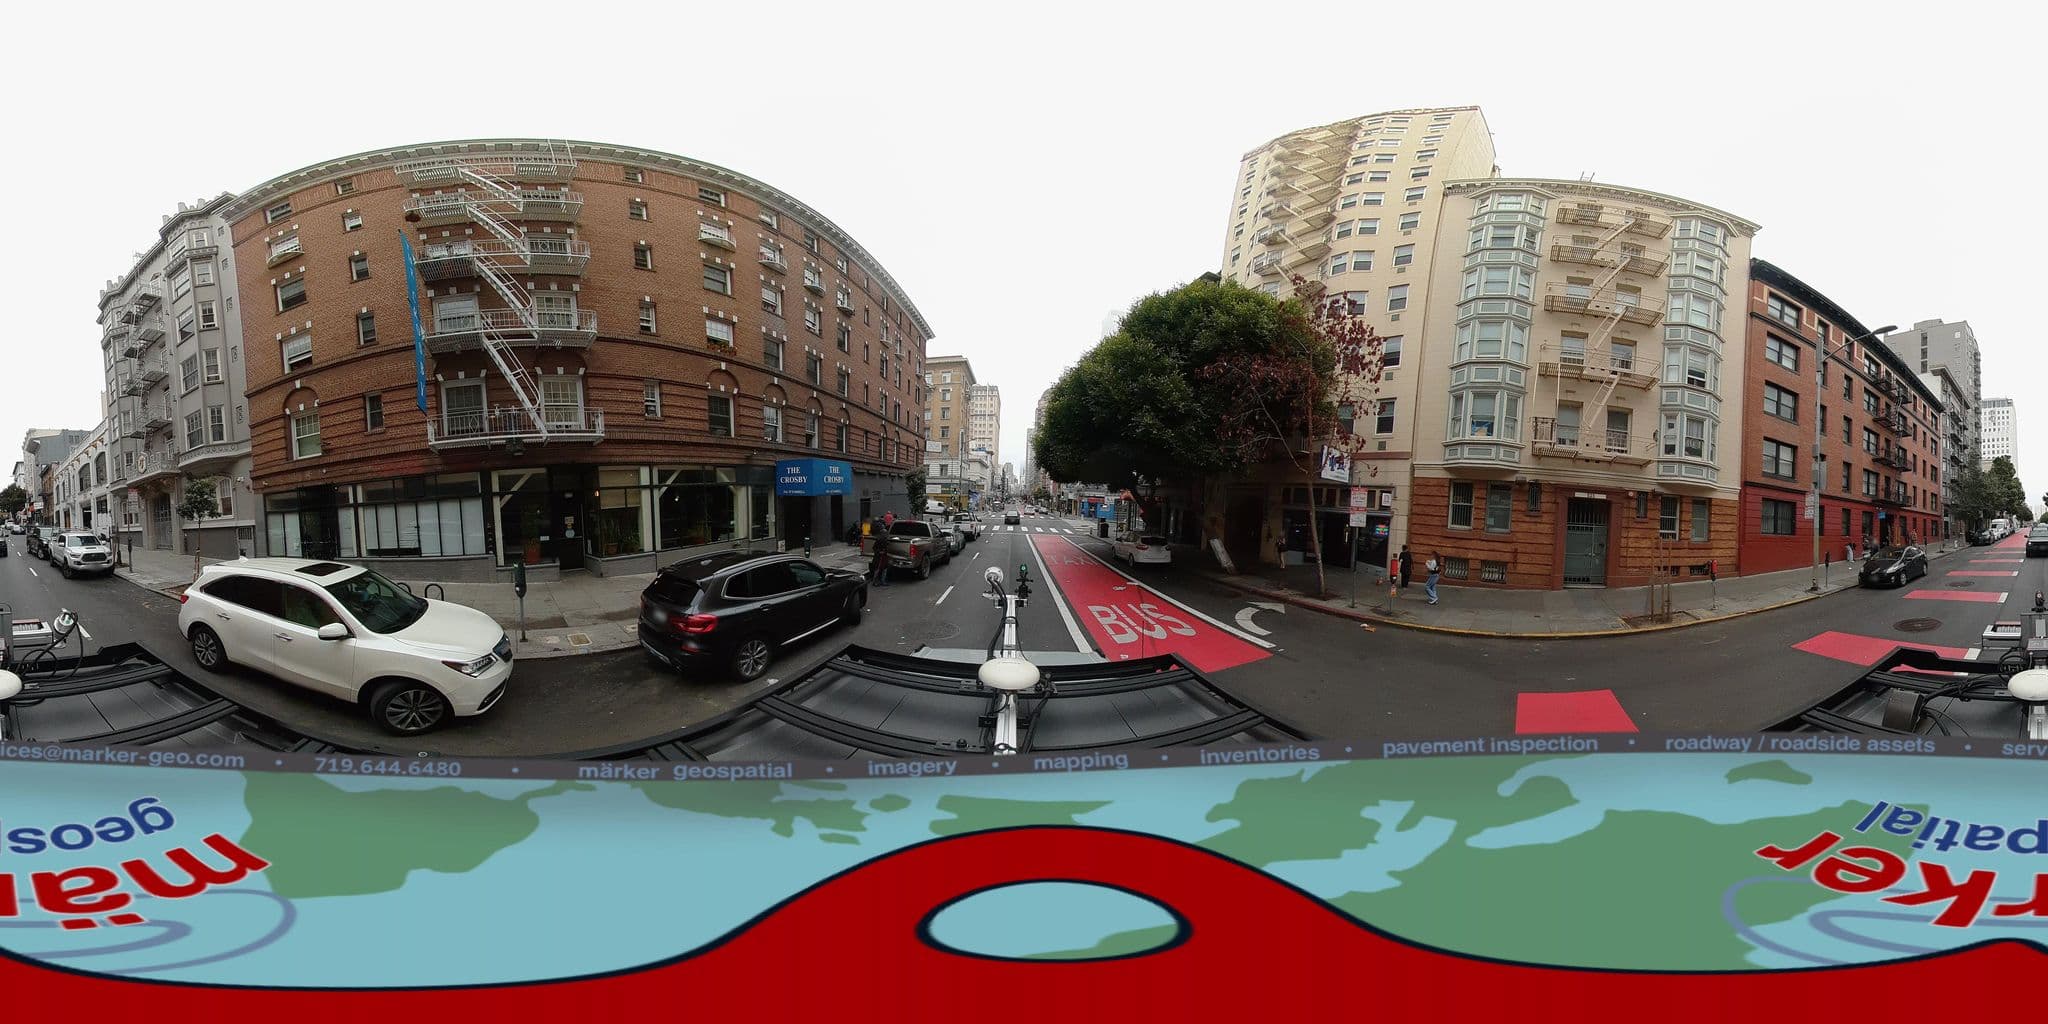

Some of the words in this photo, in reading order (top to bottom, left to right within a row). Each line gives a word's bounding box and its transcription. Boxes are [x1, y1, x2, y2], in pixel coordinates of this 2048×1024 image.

[786, 466, 801, 475] THE
[829, 466, 840, 474] THE
[780, 475, 808, 484] CROSBY
[823, 475, 844, 484] CROSBY
[1087, 603, 1197, 645] BUS
